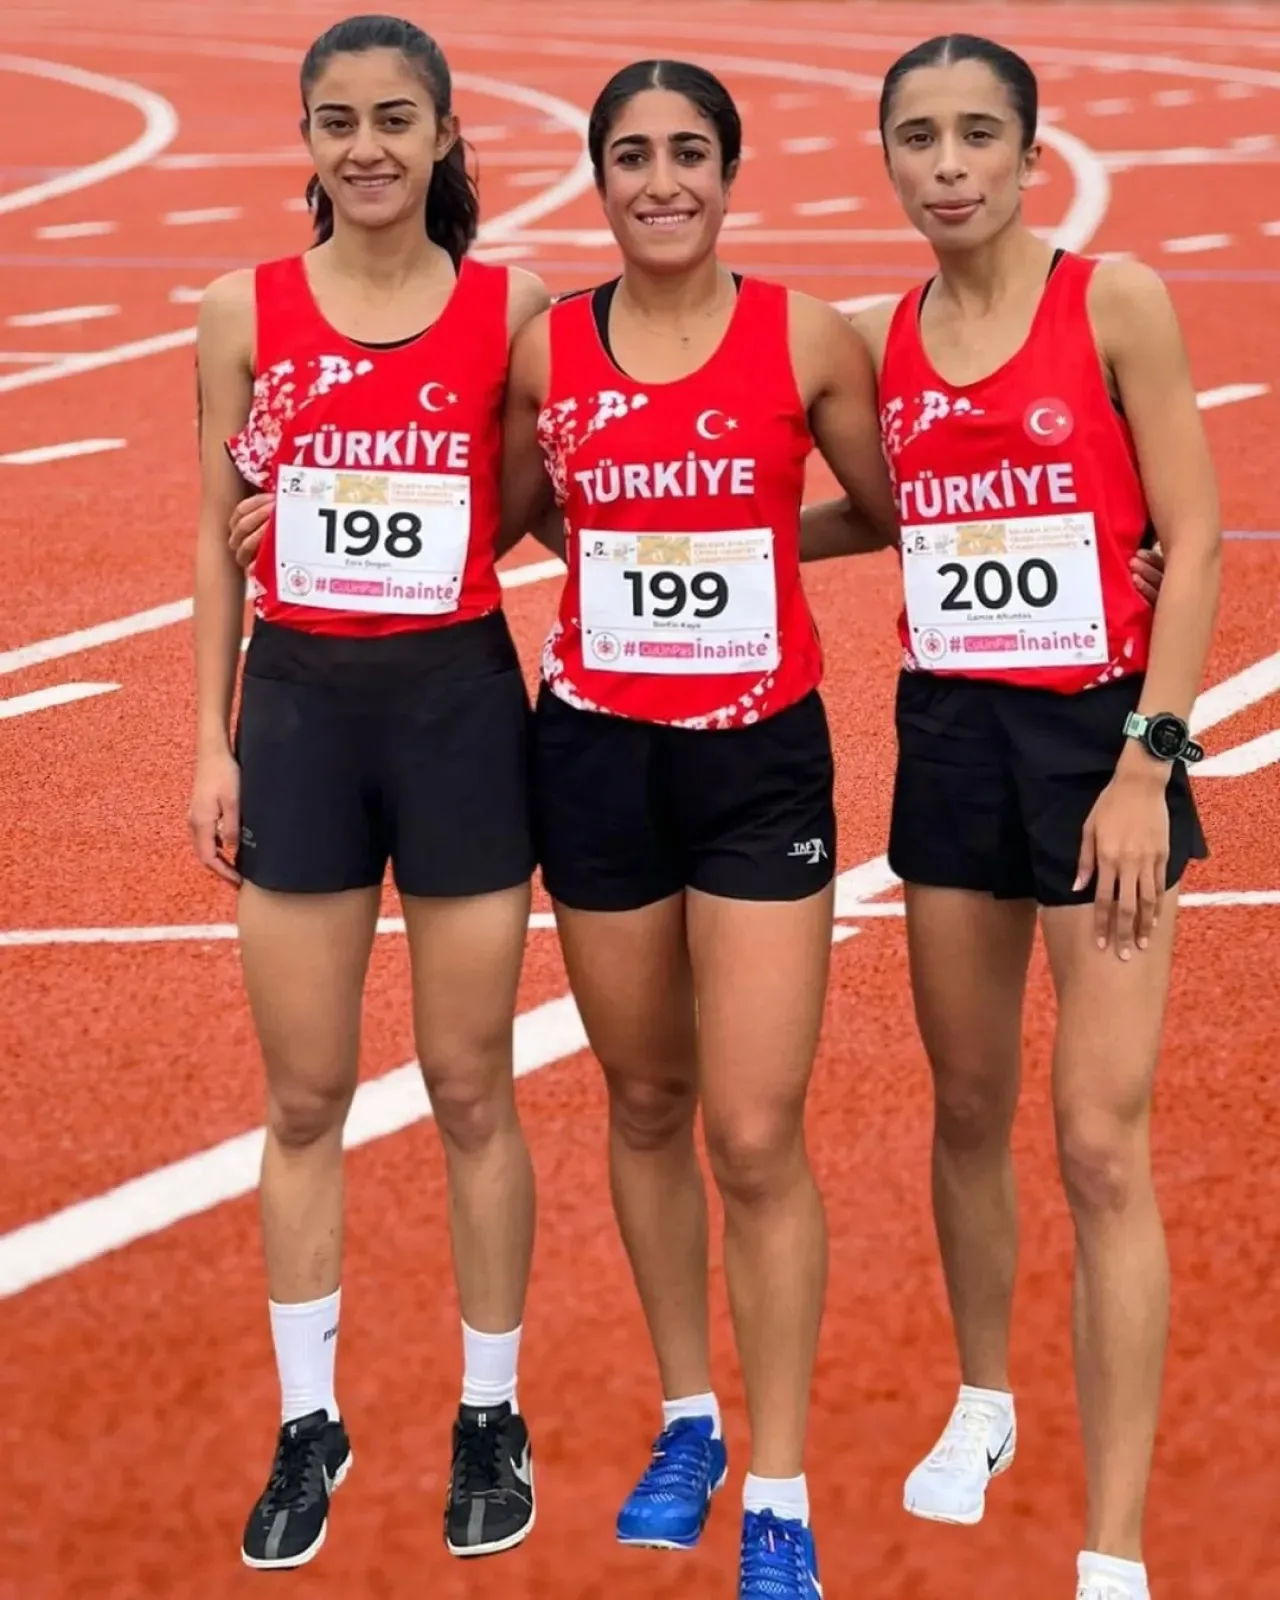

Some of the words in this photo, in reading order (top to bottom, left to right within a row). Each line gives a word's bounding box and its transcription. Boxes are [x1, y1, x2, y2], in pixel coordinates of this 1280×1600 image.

[293, 421, 471, 468] TÜRKİYE
[574, 451, 756, 505] TÜRKİYE
[900, 458, 1078, 520] TÜRKİYE
[318, 508, 423, 559] 198
[623, 570, 729, 619] 199
[936, 557, 1059, 611] 200
